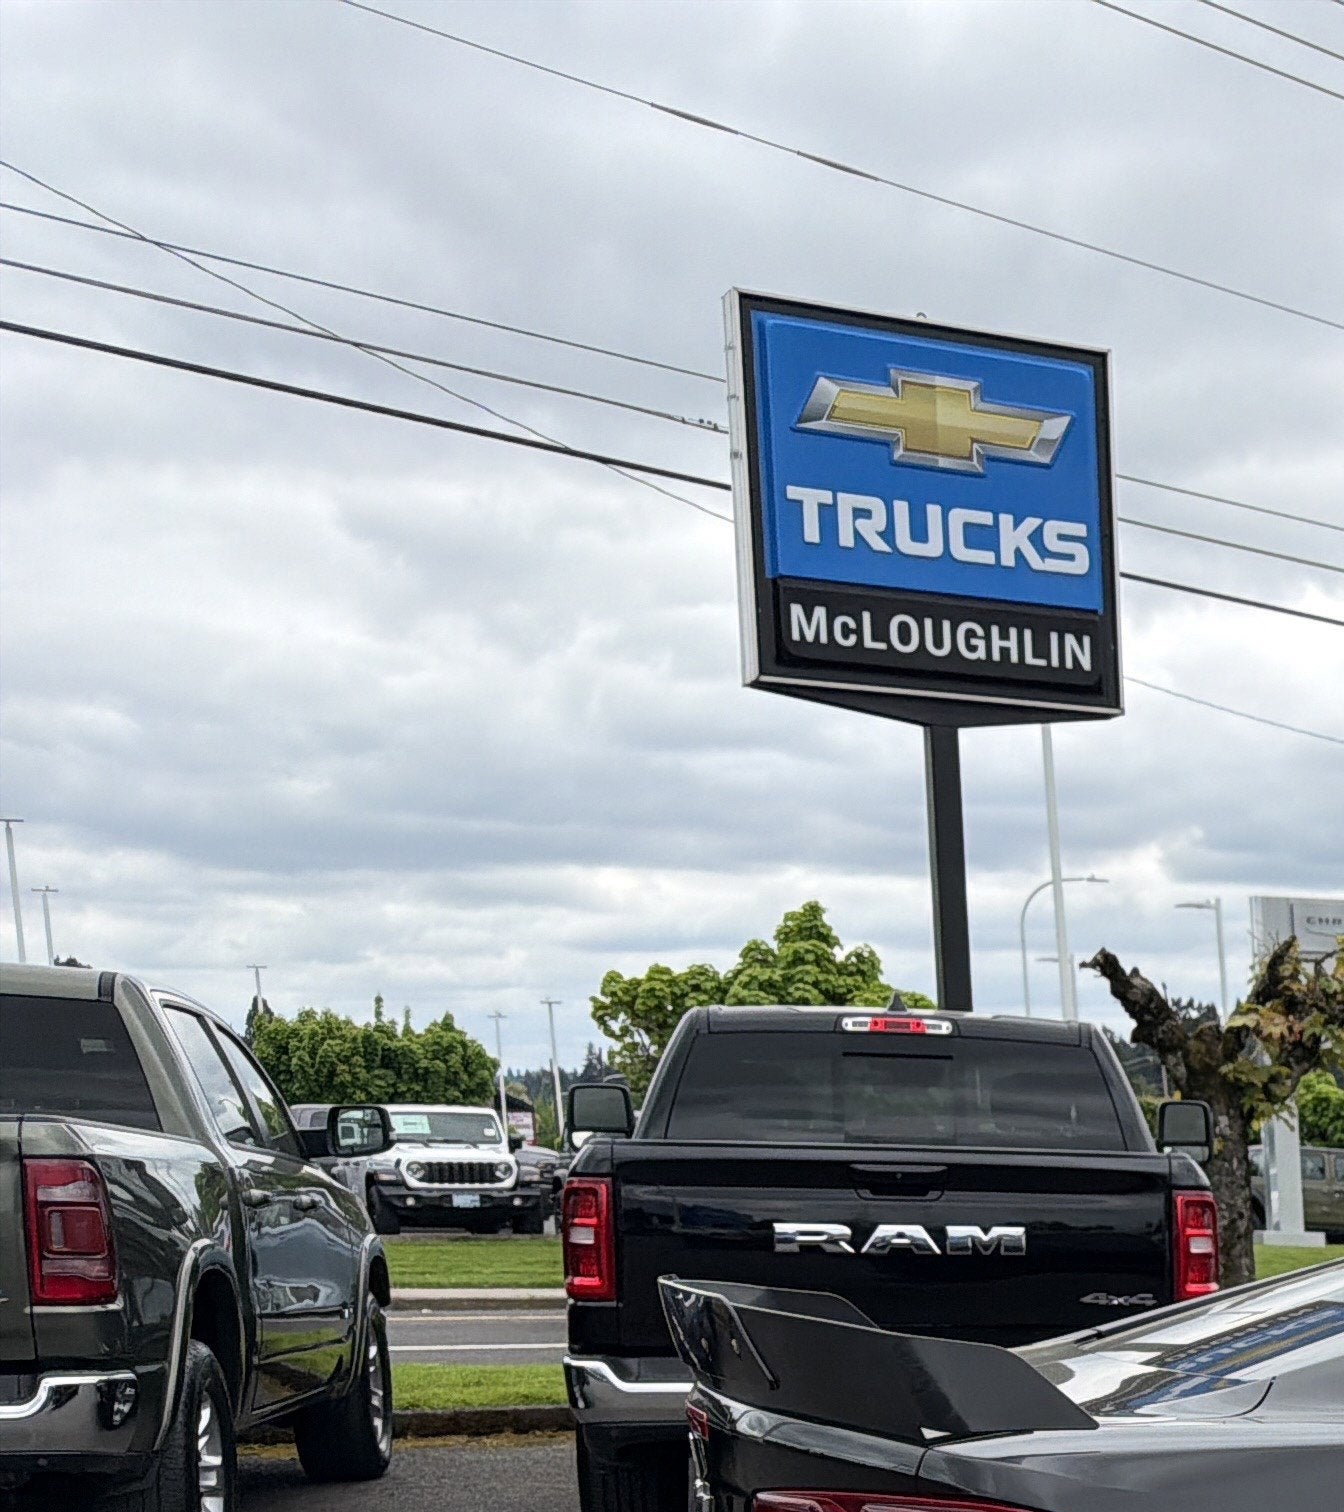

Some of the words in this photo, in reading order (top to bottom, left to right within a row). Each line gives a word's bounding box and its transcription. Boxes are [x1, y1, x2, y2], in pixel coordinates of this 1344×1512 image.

[786, 485, 1090, 575] TRUCKS
[789, 603, 1092, 672] McLOUGHLIN
[773, 1222, 1026, 1255] RAM
